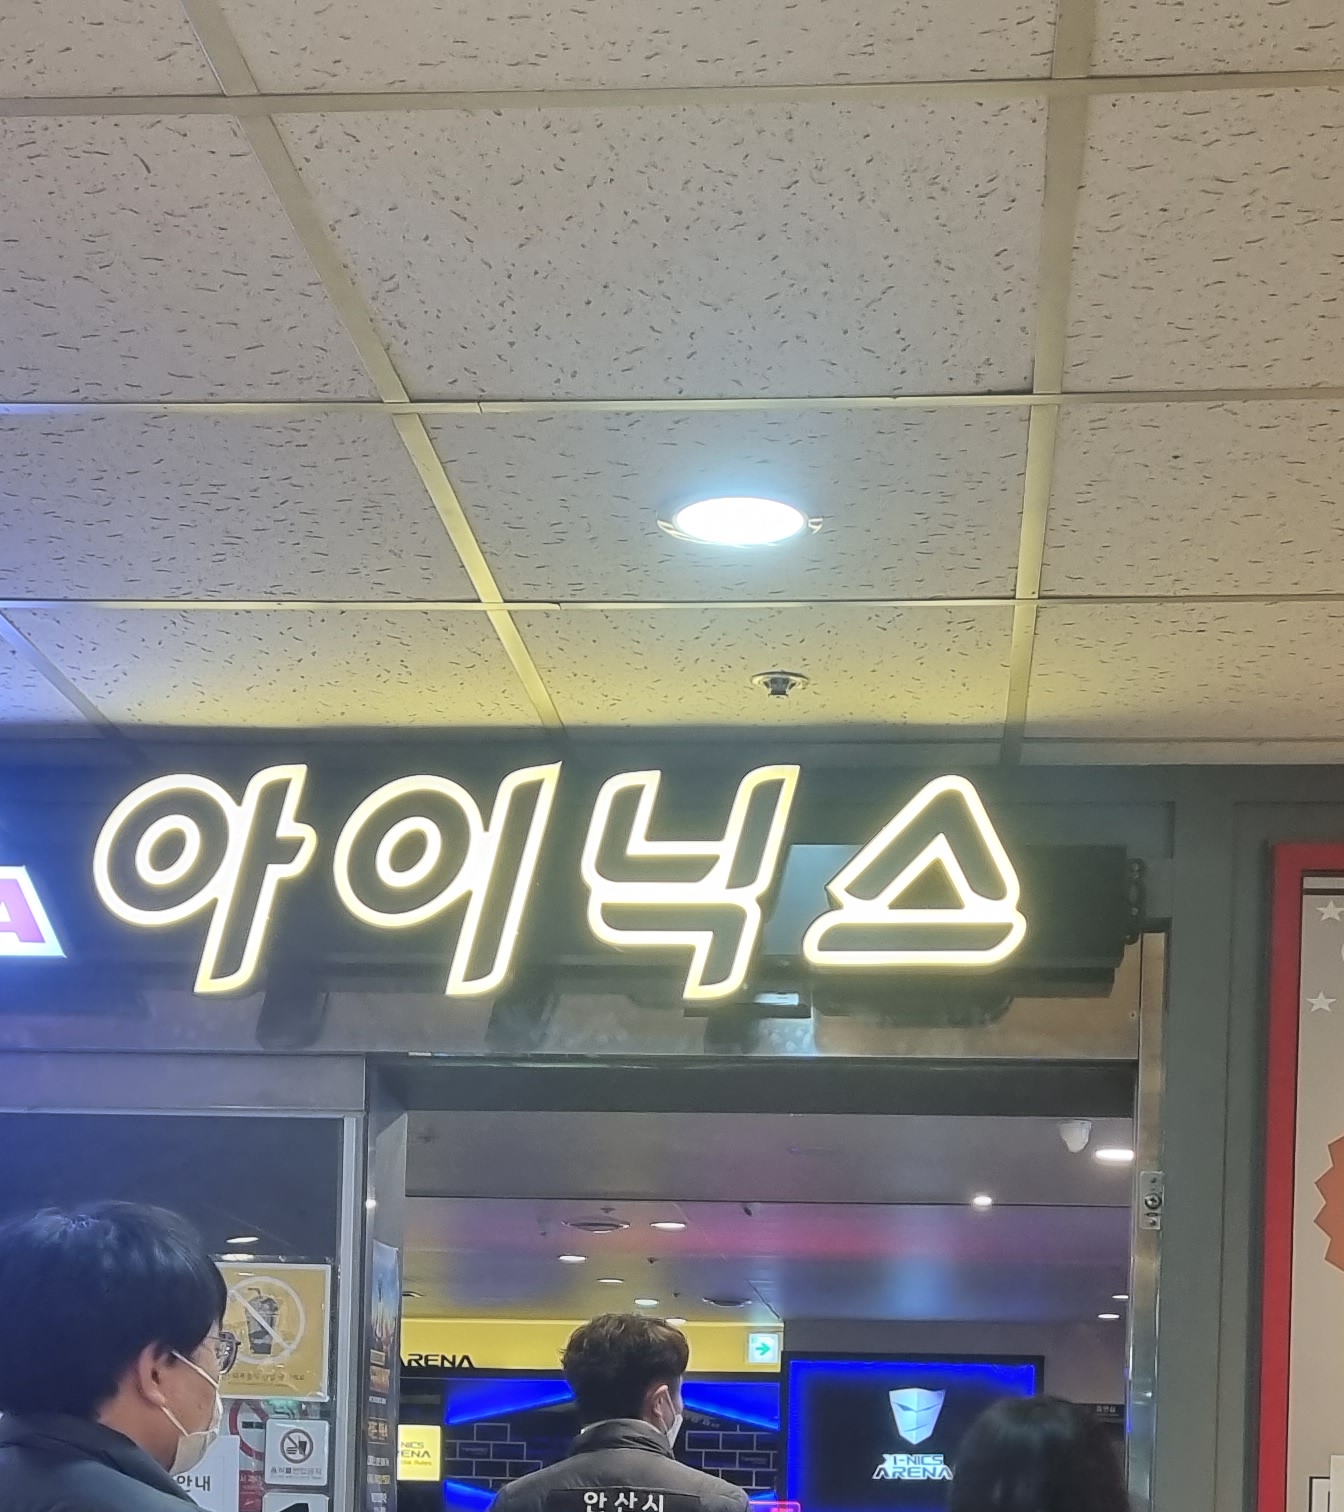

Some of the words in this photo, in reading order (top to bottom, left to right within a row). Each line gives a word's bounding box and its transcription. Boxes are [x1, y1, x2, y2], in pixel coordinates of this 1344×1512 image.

[92, 763, 1028, 1000] 아이닉스
[893, 1455, 943, 1466] I-NICS
[874, 1466, 954, 1479] ARENA
